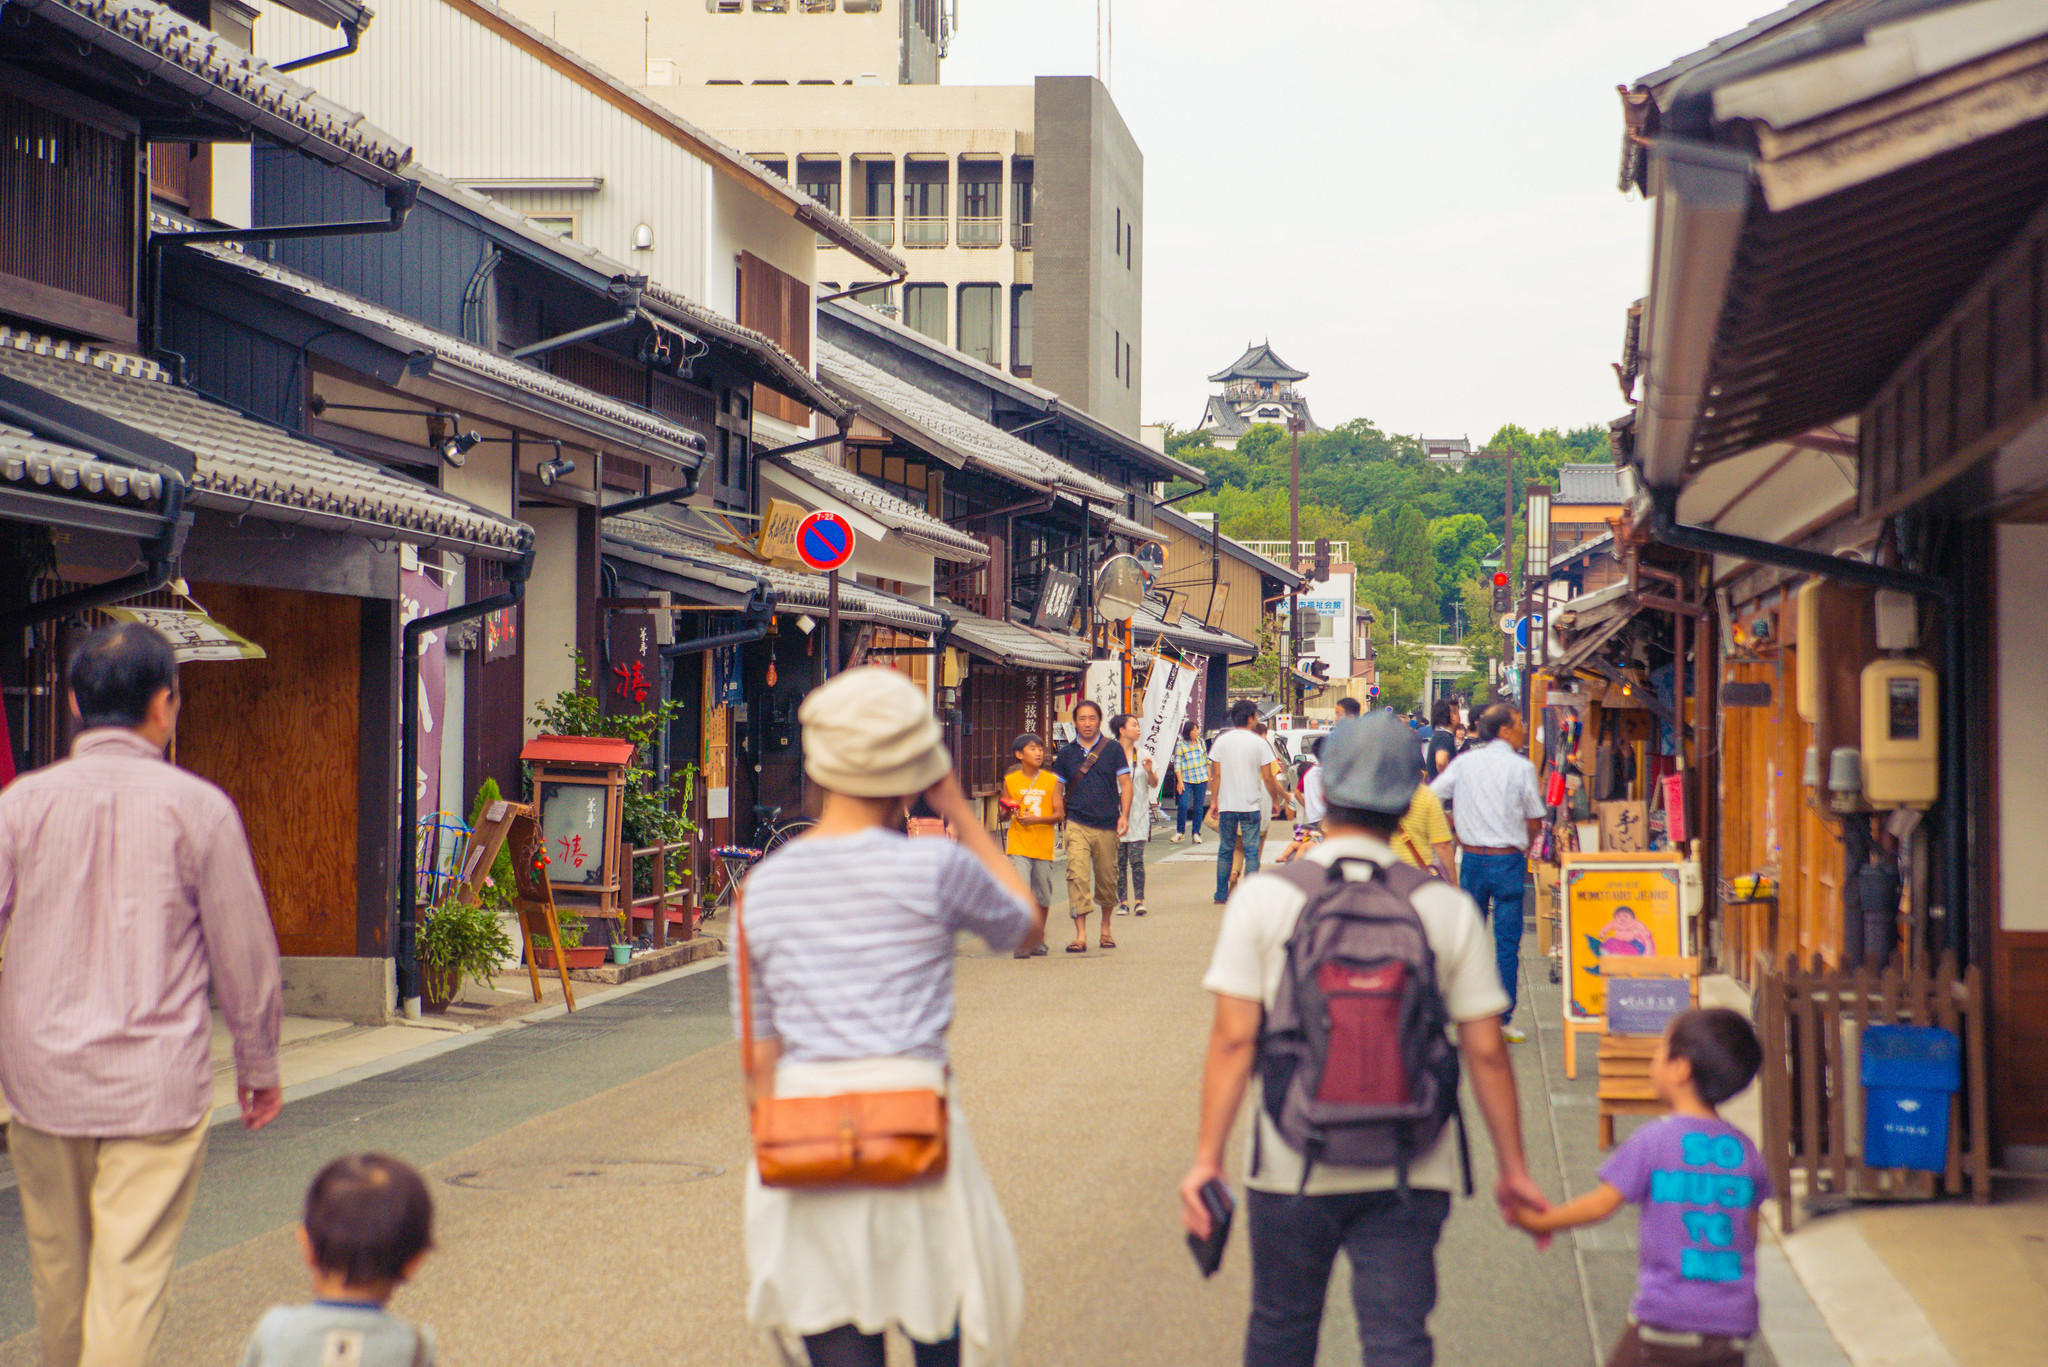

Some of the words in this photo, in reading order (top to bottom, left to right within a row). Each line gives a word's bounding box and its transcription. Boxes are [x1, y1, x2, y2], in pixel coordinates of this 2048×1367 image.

[816, 513, 835, 521] 7-22
[1281, 601, 1342, 610] 犬市福祉会館
[1504, 619, 1516, 629] 30
[1020, 788, 1046, 796] adidas
[557, 834, 588, 868] 椿
[1681, 1131, 1744, 1169] SO
